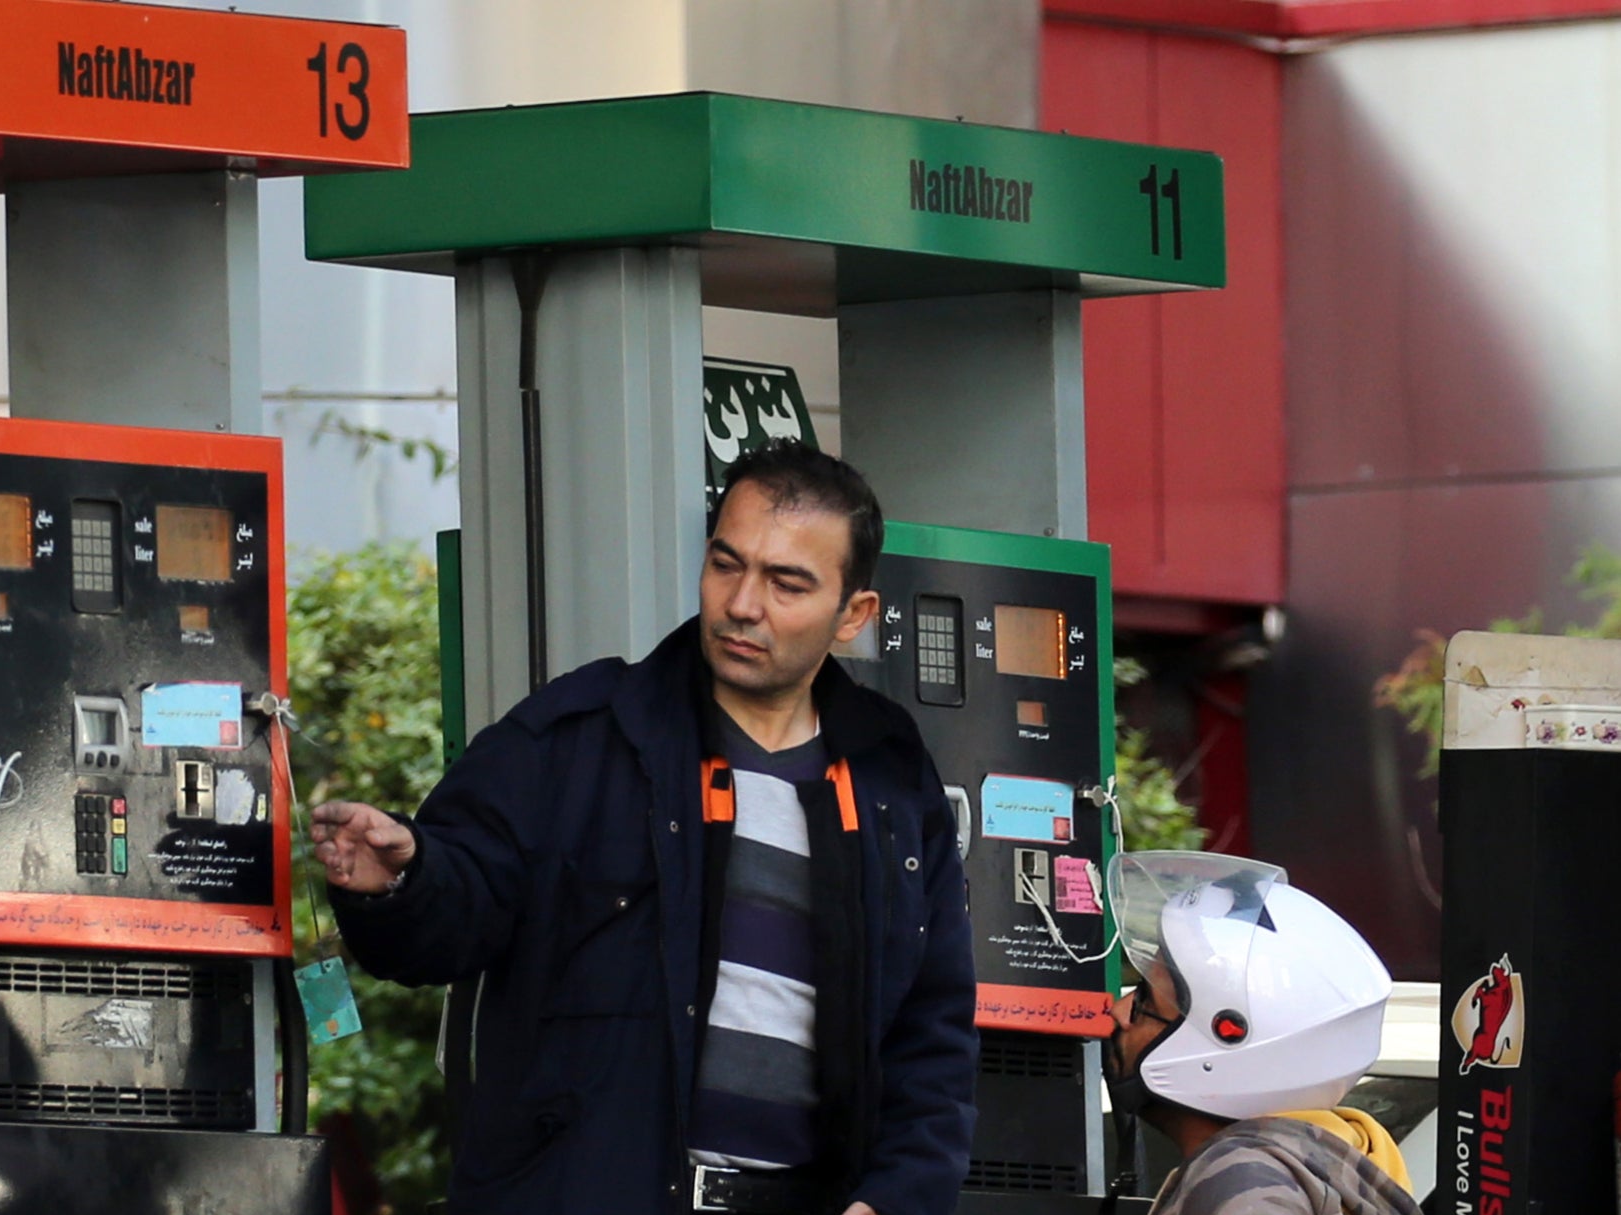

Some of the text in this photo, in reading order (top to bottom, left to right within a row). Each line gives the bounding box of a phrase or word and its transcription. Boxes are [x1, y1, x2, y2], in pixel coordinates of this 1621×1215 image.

[57, 41, 195, 106] NaftAbzar
[306, 42, 371, 141] 13
[910, 159, 1033, 223] NaftAbzar
[1140, 165, 1182, 261] 11
[135, 517, 153, 534] sale
[135, 545, 154, 562] liter
[976, 616, 993, 633] sale
[976, 643, 994, 660] liter
[1457, 1110, 1475, 1120] I
[1456, 1125, 1475, 1194] Love
